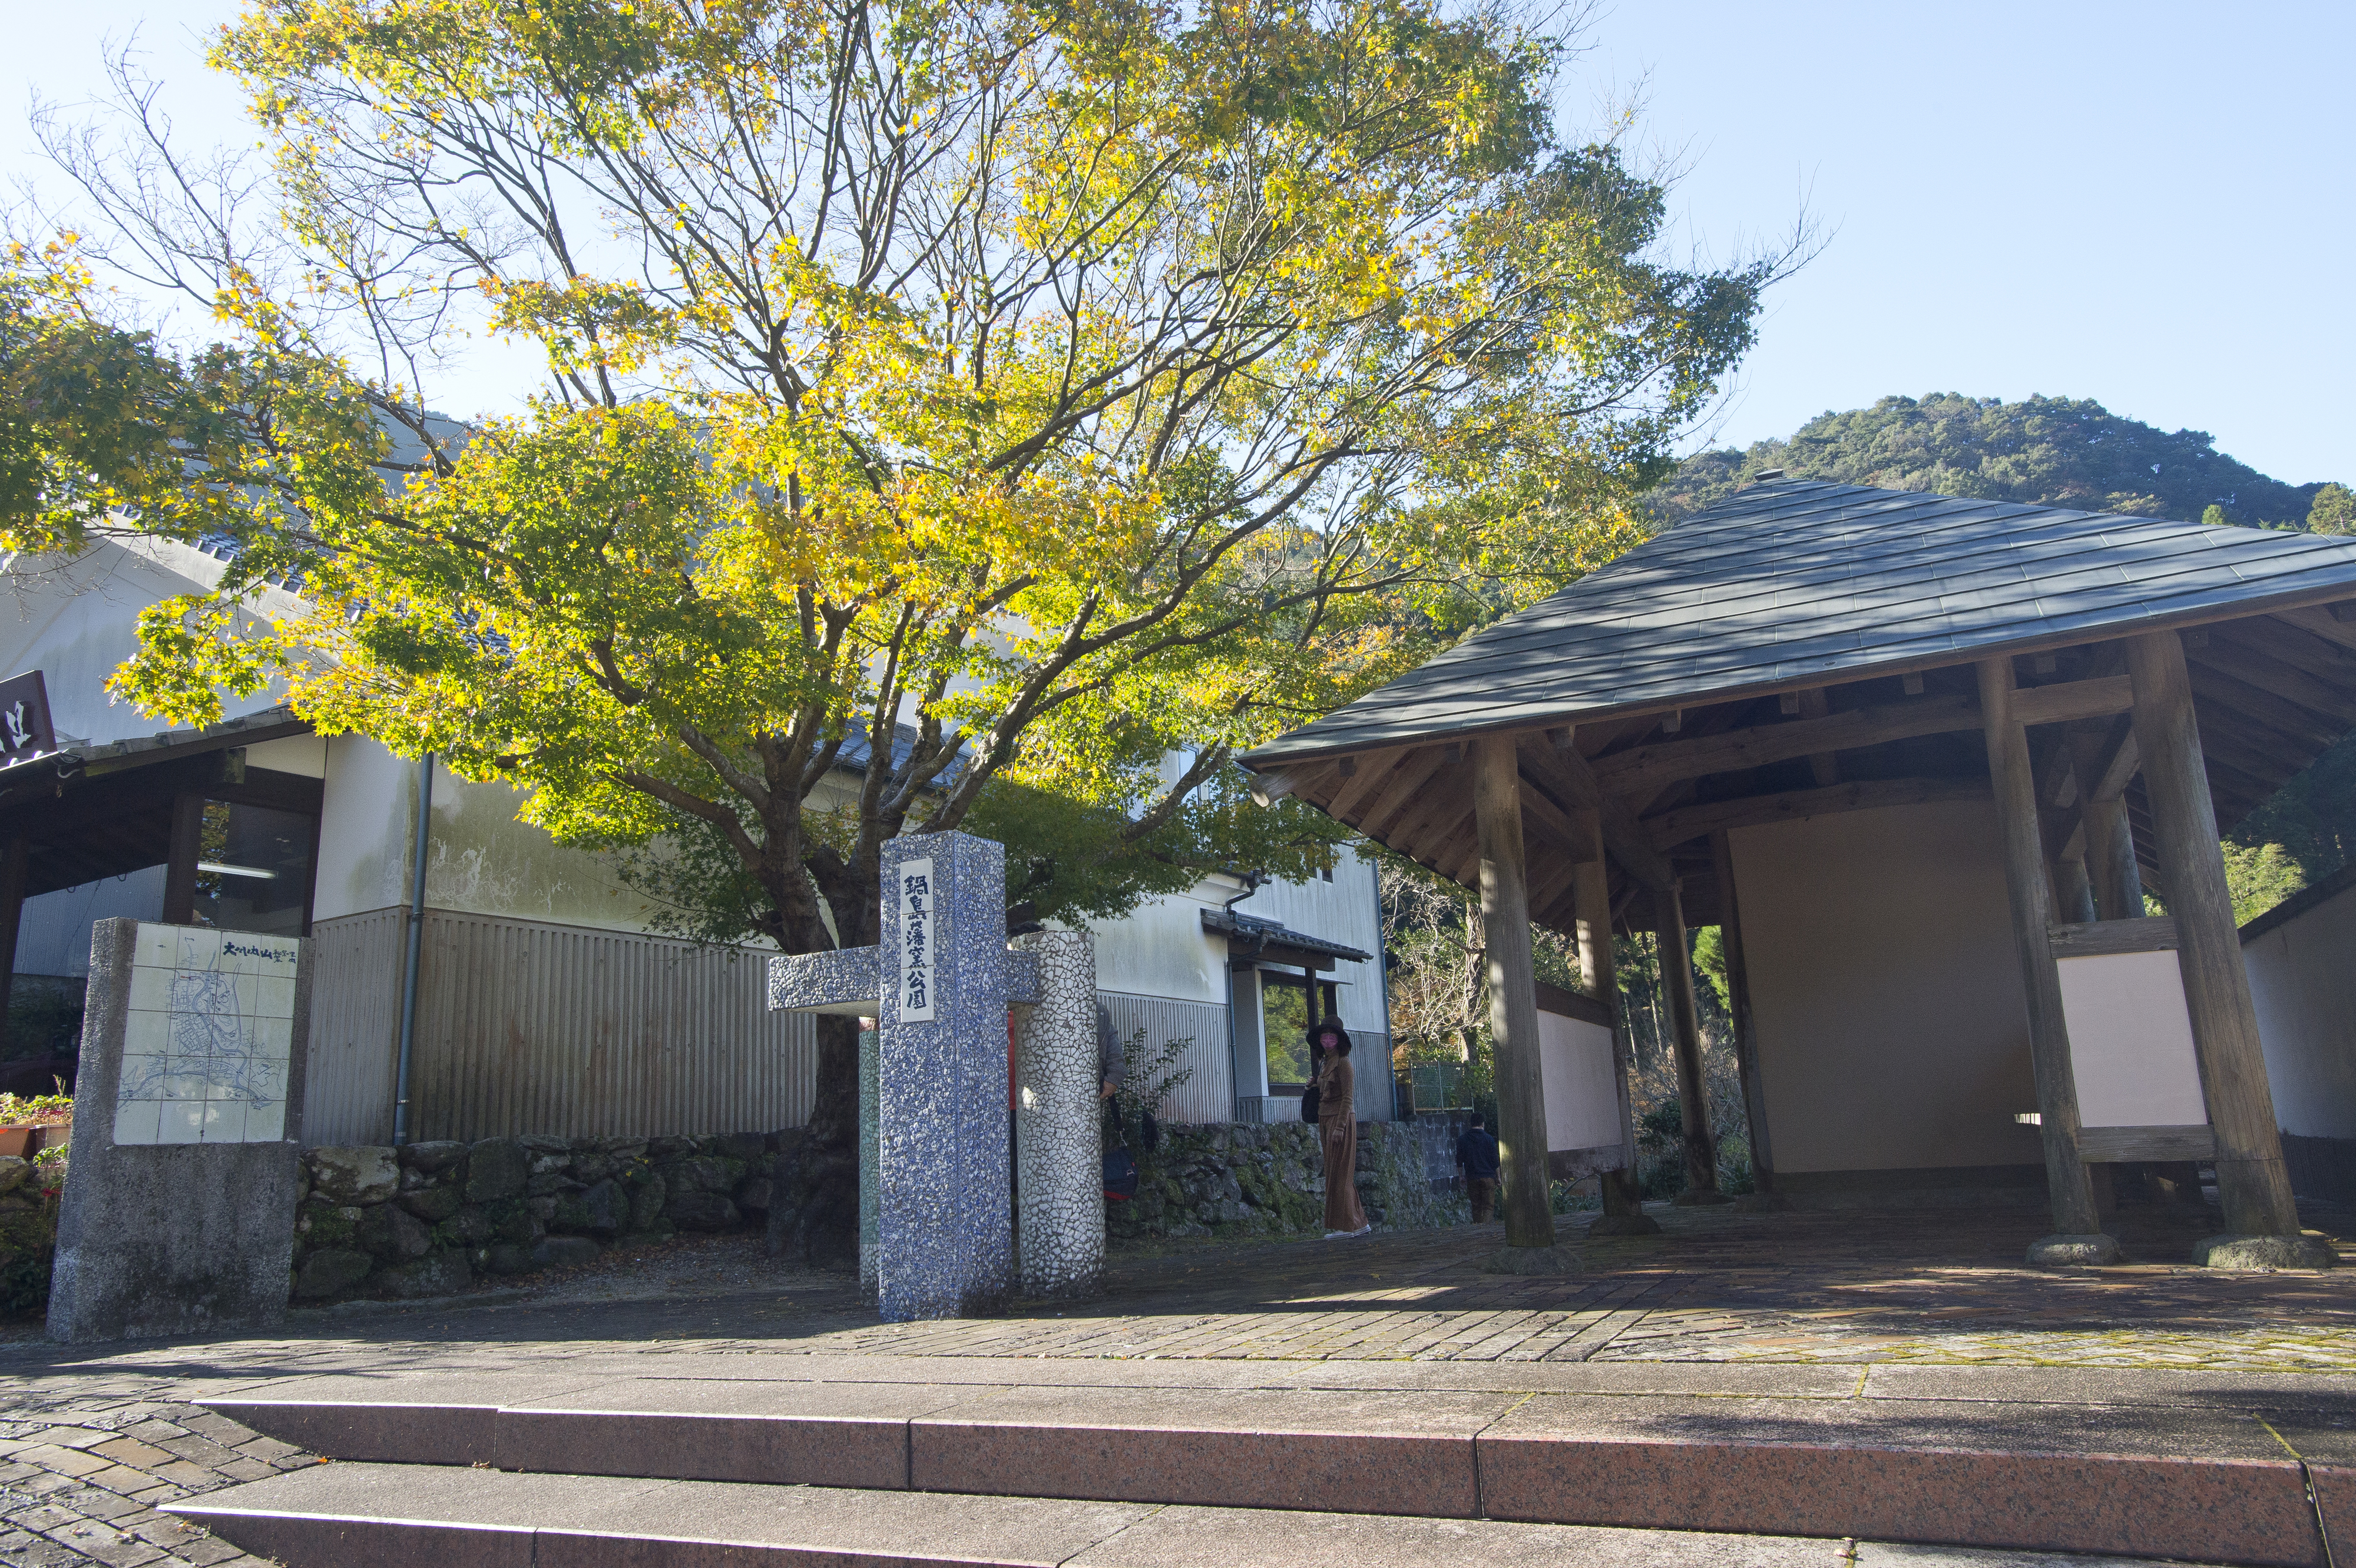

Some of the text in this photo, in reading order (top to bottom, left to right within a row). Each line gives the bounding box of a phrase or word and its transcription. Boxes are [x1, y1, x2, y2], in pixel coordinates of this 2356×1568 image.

[904, 875, 929, 1010] 鍋島藩窯公園
